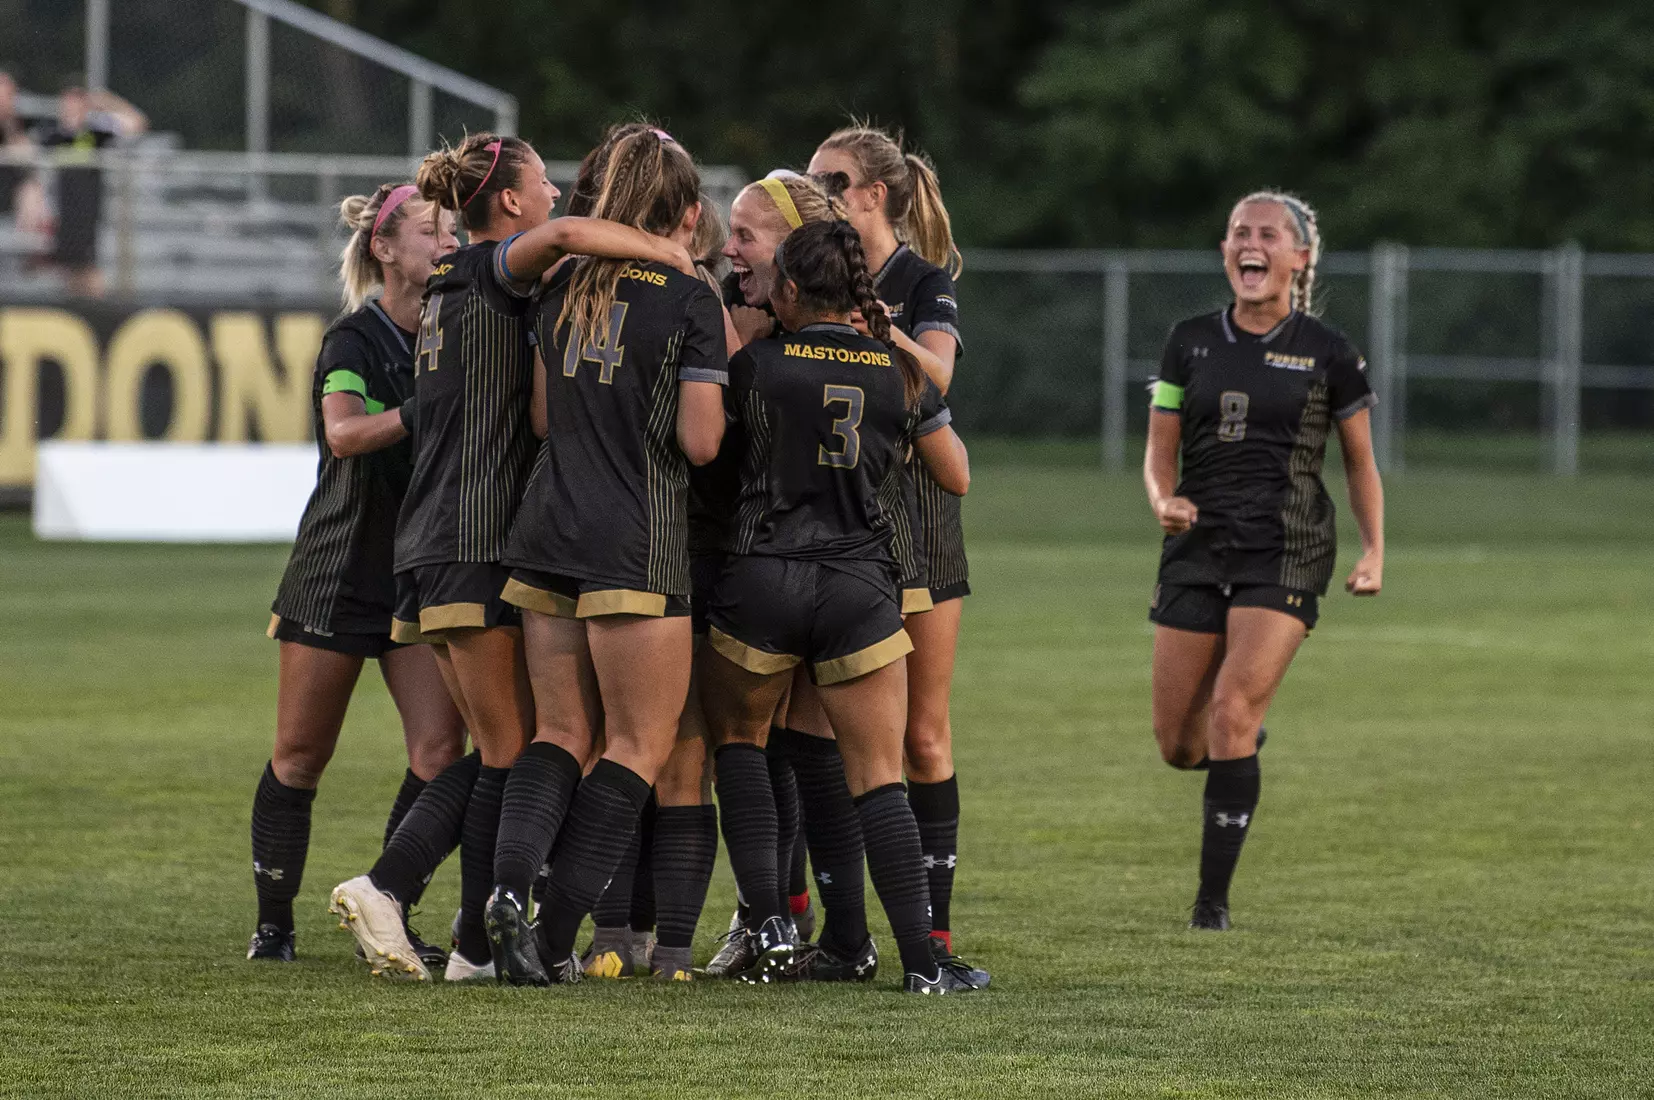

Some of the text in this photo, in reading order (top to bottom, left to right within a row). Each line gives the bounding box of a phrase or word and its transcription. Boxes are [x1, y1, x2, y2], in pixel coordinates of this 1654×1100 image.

[784, 343, 892, 367] MASTODONS
[818, 384, 865, 470] 3
[1217, 390, 1250, 442] 8
